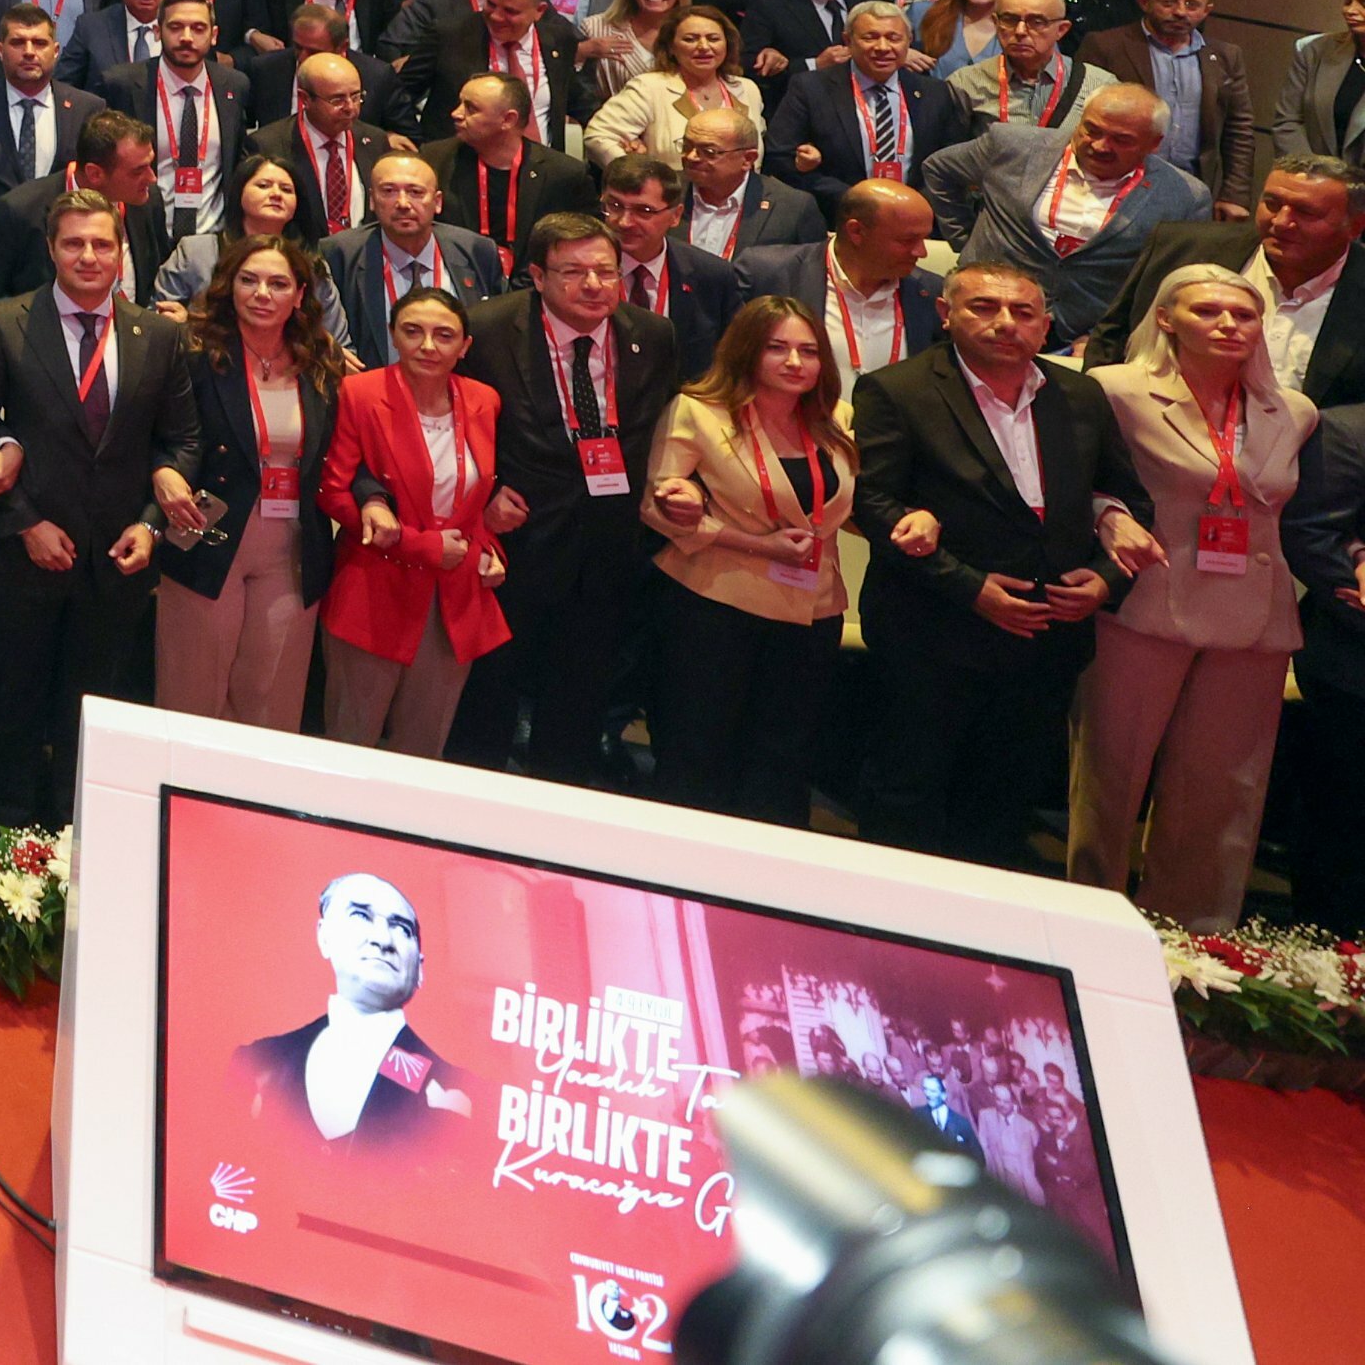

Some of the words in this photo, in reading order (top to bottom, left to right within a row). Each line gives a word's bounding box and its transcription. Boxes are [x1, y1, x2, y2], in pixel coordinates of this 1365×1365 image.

[491, 981, 683, 1083] BİRLİKTE
[492, 1139, 685, 1214] Kuracağız
[497, 1079, 694, 1187] BİRLİKTE
[209, 1202, 259, 1235] CHP
